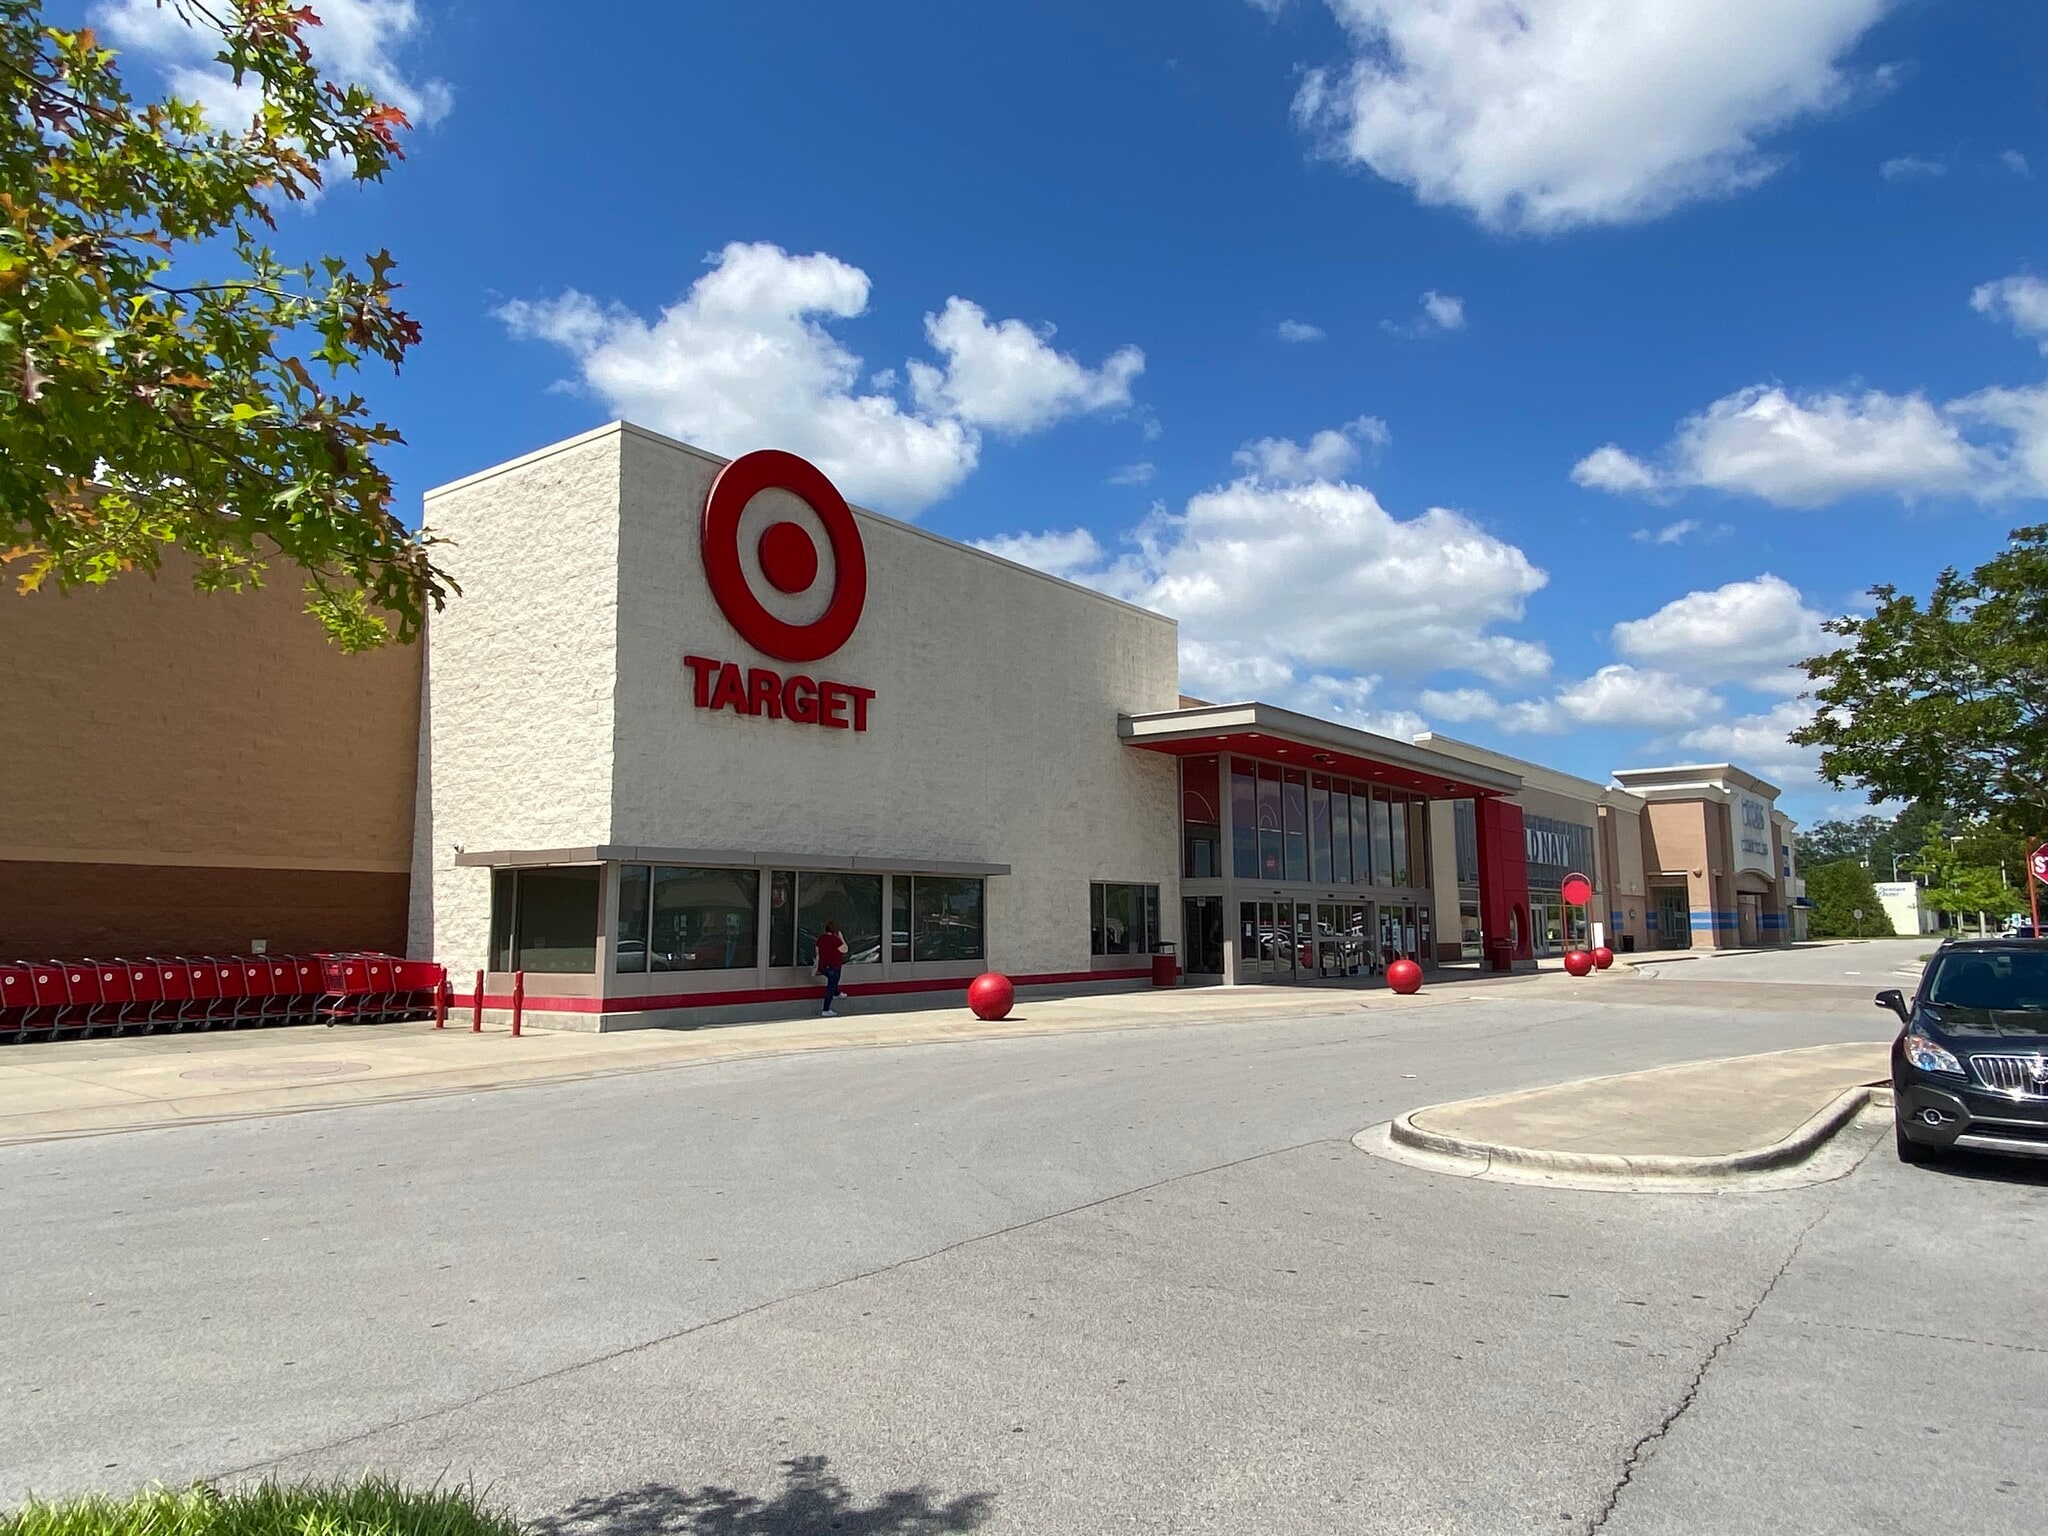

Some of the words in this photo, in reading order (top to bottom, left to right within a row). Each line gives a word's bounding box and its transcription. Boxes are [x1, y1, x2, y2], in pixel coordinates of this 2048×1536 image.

[684, 655, 876, 731] TARGET
[1524, 829, 1539, 864] LD
[1541, 831, 1571, 868] NAVY
